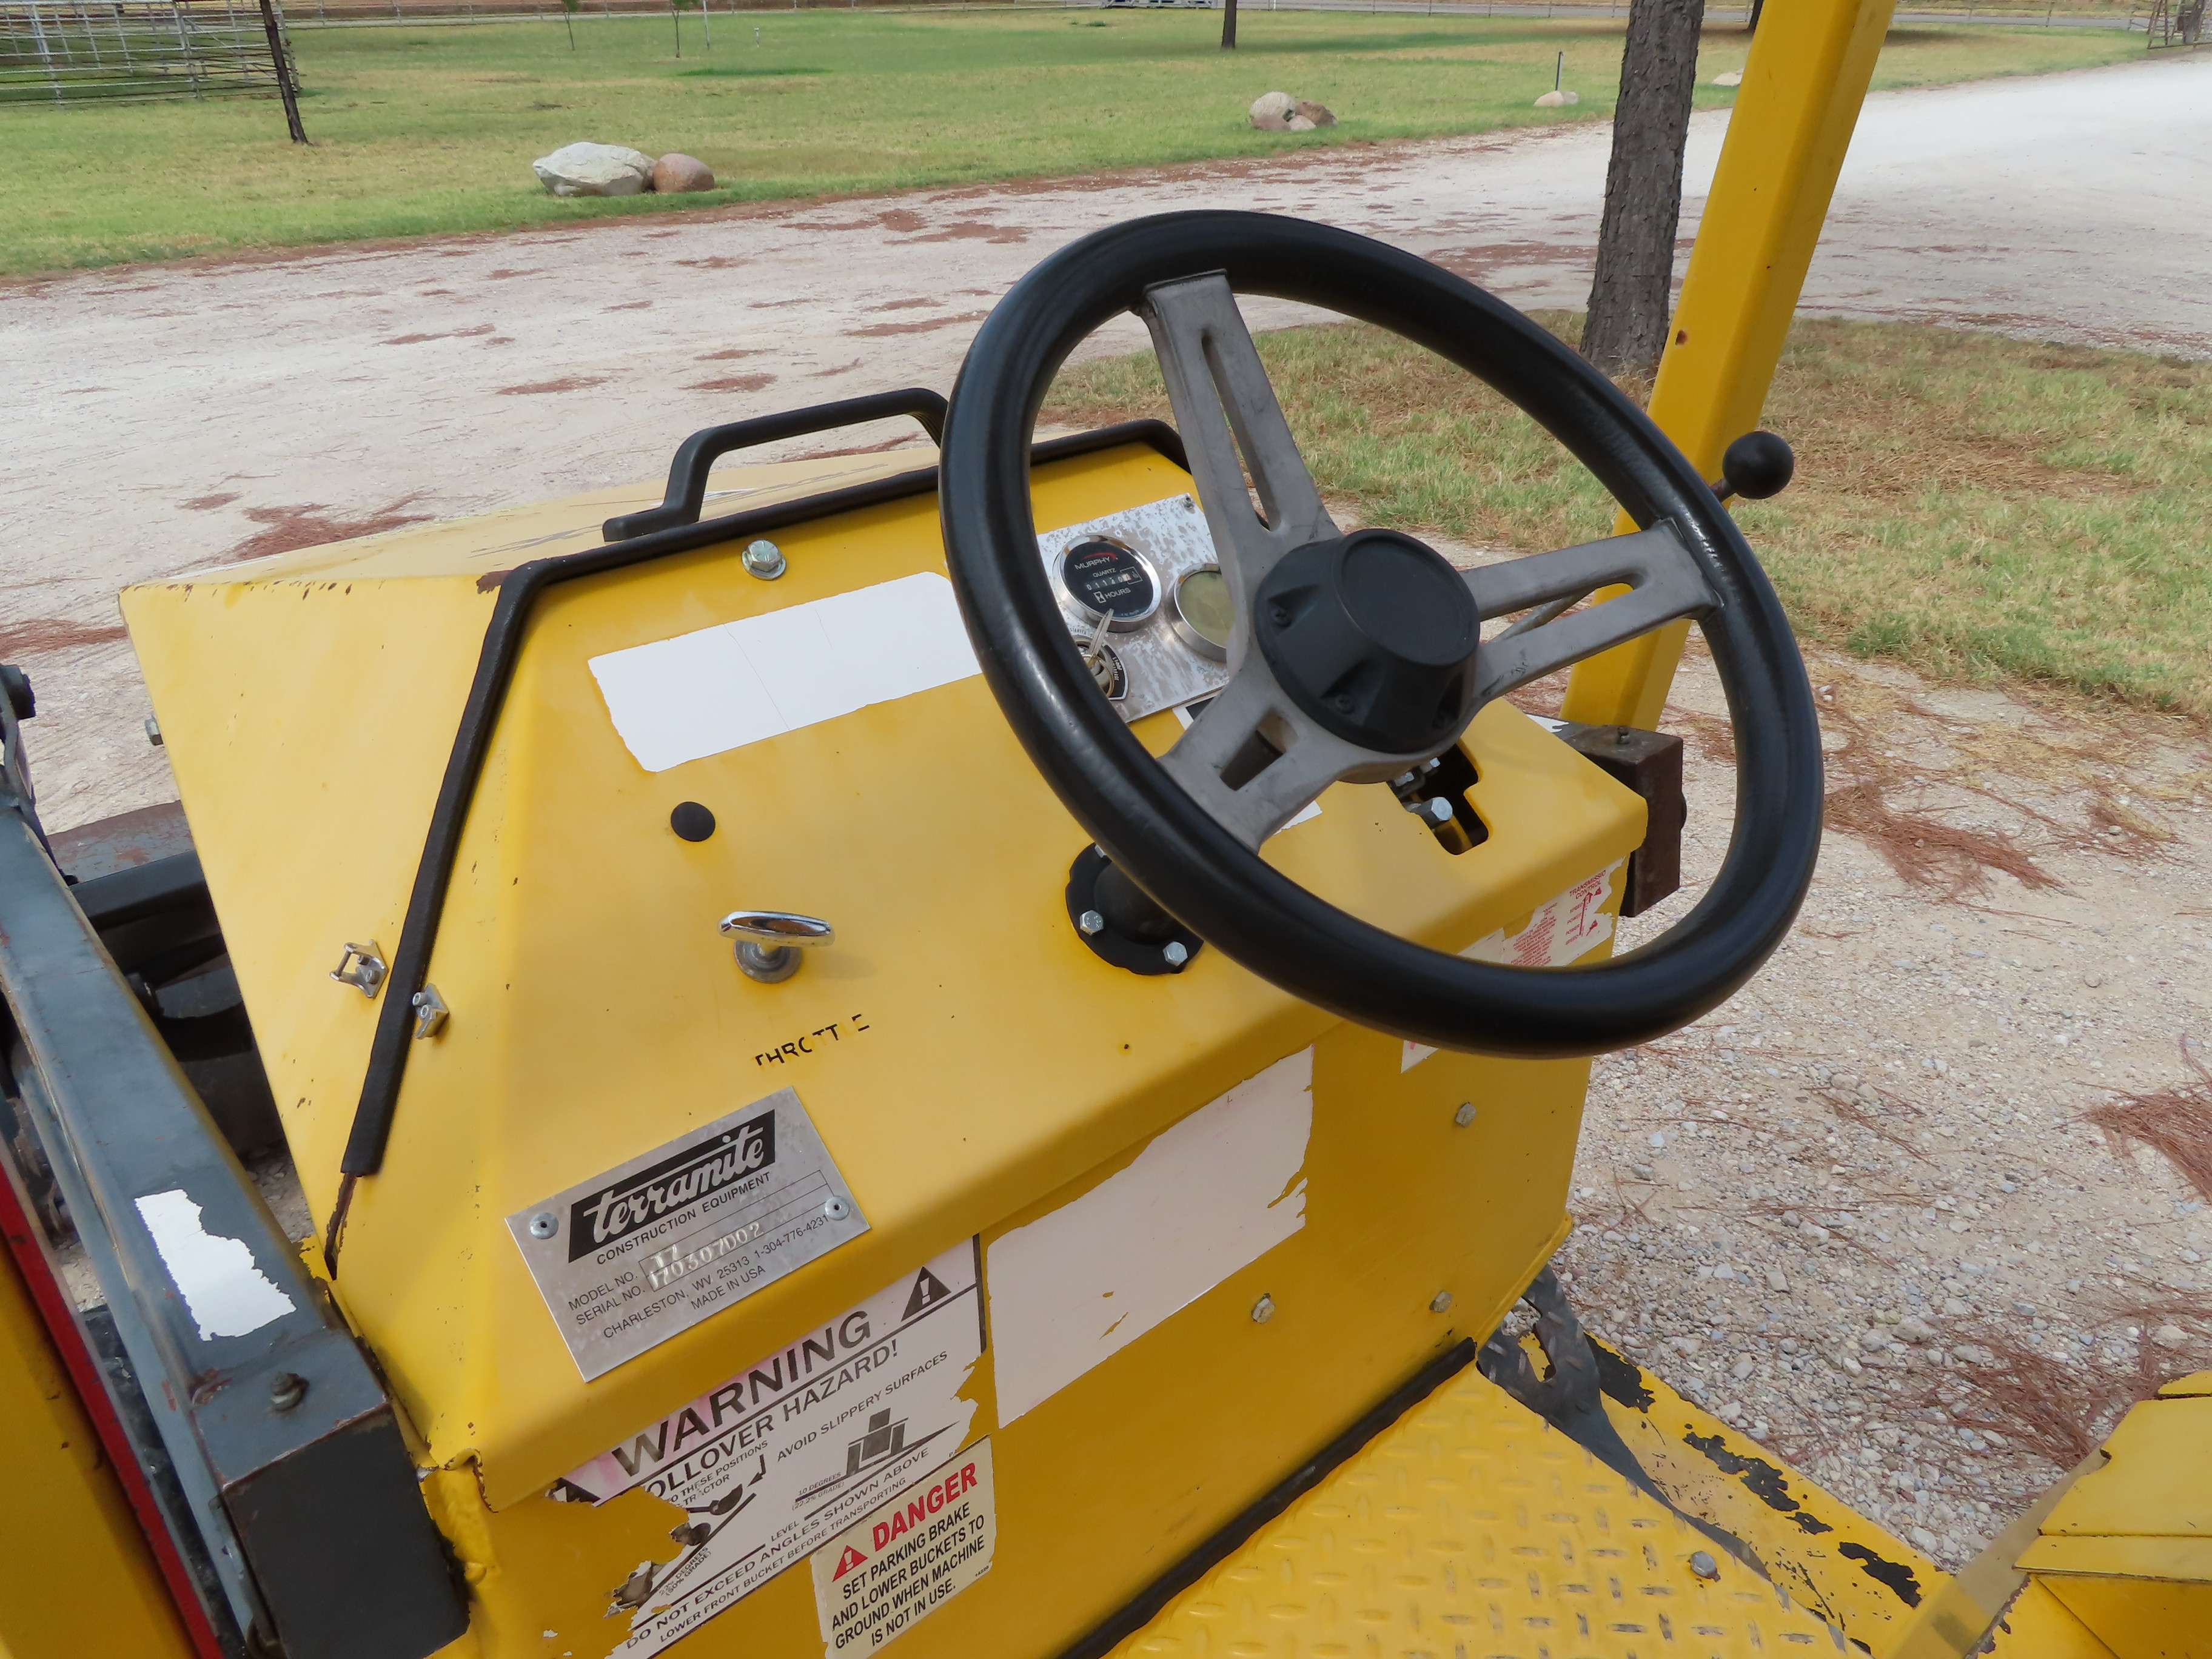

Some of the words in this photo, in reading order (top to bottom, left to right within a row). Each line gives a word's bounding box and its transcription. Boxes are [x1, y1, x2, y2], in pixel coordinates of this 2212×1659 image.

[1074, 556, 1111, 570] MURPHY
[1093, 568, 1116, 577] QUARTZ
[1104, 588, 1131, 599] HOURS
[1576, 879, 1601, 899] CONTROL
[597, 1213, 697, 1265] CONSTRUCTION
[703, 1172, 771, 1212] EQUIPMENT
[569, 1279, 614, 1310] MODEL
[614, 1271, 638, 1288] NO.
[603, 1289, 689, 1338] CHARLESTON,
[692, 1276, 712, 1292] WV
[717, 1256, 749, 1279] 25313
[754, 1215, 829, 1258] 1-304-776-4231
[691, 1286, 726, 1310] MADE
[727, 1280, 740, 1292] IN
[742, 1265, 765, 1284] USA
[577, 1296, 620, 1326] SERIAL
[622, 1285, 645, 1304] NO.
[611, 1311, 871, 1476] WARNING
[777, 1432, 817, 1463] AVOID
[820, 1390, 883, 1435] SLIPPERY
[885, 1351, 947, 1395] SURFACES
[783, 1339, 897, 1422] HAZARD!
[681, 1473, 713, 1496] THESE
[716, 1440, 768, 1476] POSITIONS
[809, 1472, 841, 1490] DEGREES
[818, 1481, 844, 1498] GRADE)
[771, 1520, 799, 1543] LEVEL
[872, 1463, 977, 1552] DANGER
[626, 1628, 651, 1649] DO
[657, 1602, 689, 1630] NOT
[694, 1561, 756, 1605] EXCEED
[760, 1519, 820, 1563] ANGLES
[824, 1480, 879, 1520] SHOWN
[883, 1447, 929, 1483] ABOVE
[660, 1610, 701, 1643] LOWER
[704, 1585, 740, 1614] FRONT
[743, 1555, 785, 1589] BUCKET
[788, 1529, 828, 1559] BEFORE
[830, 1477, 907, 1530] TRANSPORTING
[675, 1546, 708, 1579] DEGREES
[684, 1551, 712, 1577] GRADE)
[832, 1603, 859, 1631] AND
[862, 1569, 907, 1610] LOWER
[910, 1527, 966, 1576] BUCKETS
[968, 1515, 984, 1535] TO
[843, 1572, 866, 1600] SET
[871, 1533, 926, 1581] PARKING
[929, 1501, 970, 1542] BRAKE
[836, 1603, 889, 1649] GROUND
[893, 1576, 929, 1609] WHEN
[932, 1535, 985, 1581] MACHINE
[871, 1629, 883, 1647] IS
[886, 1609, 911, 1637] NOT
[914, 1600, 926, 1617] IN
[929, 1578, 957, 1606] USE.
